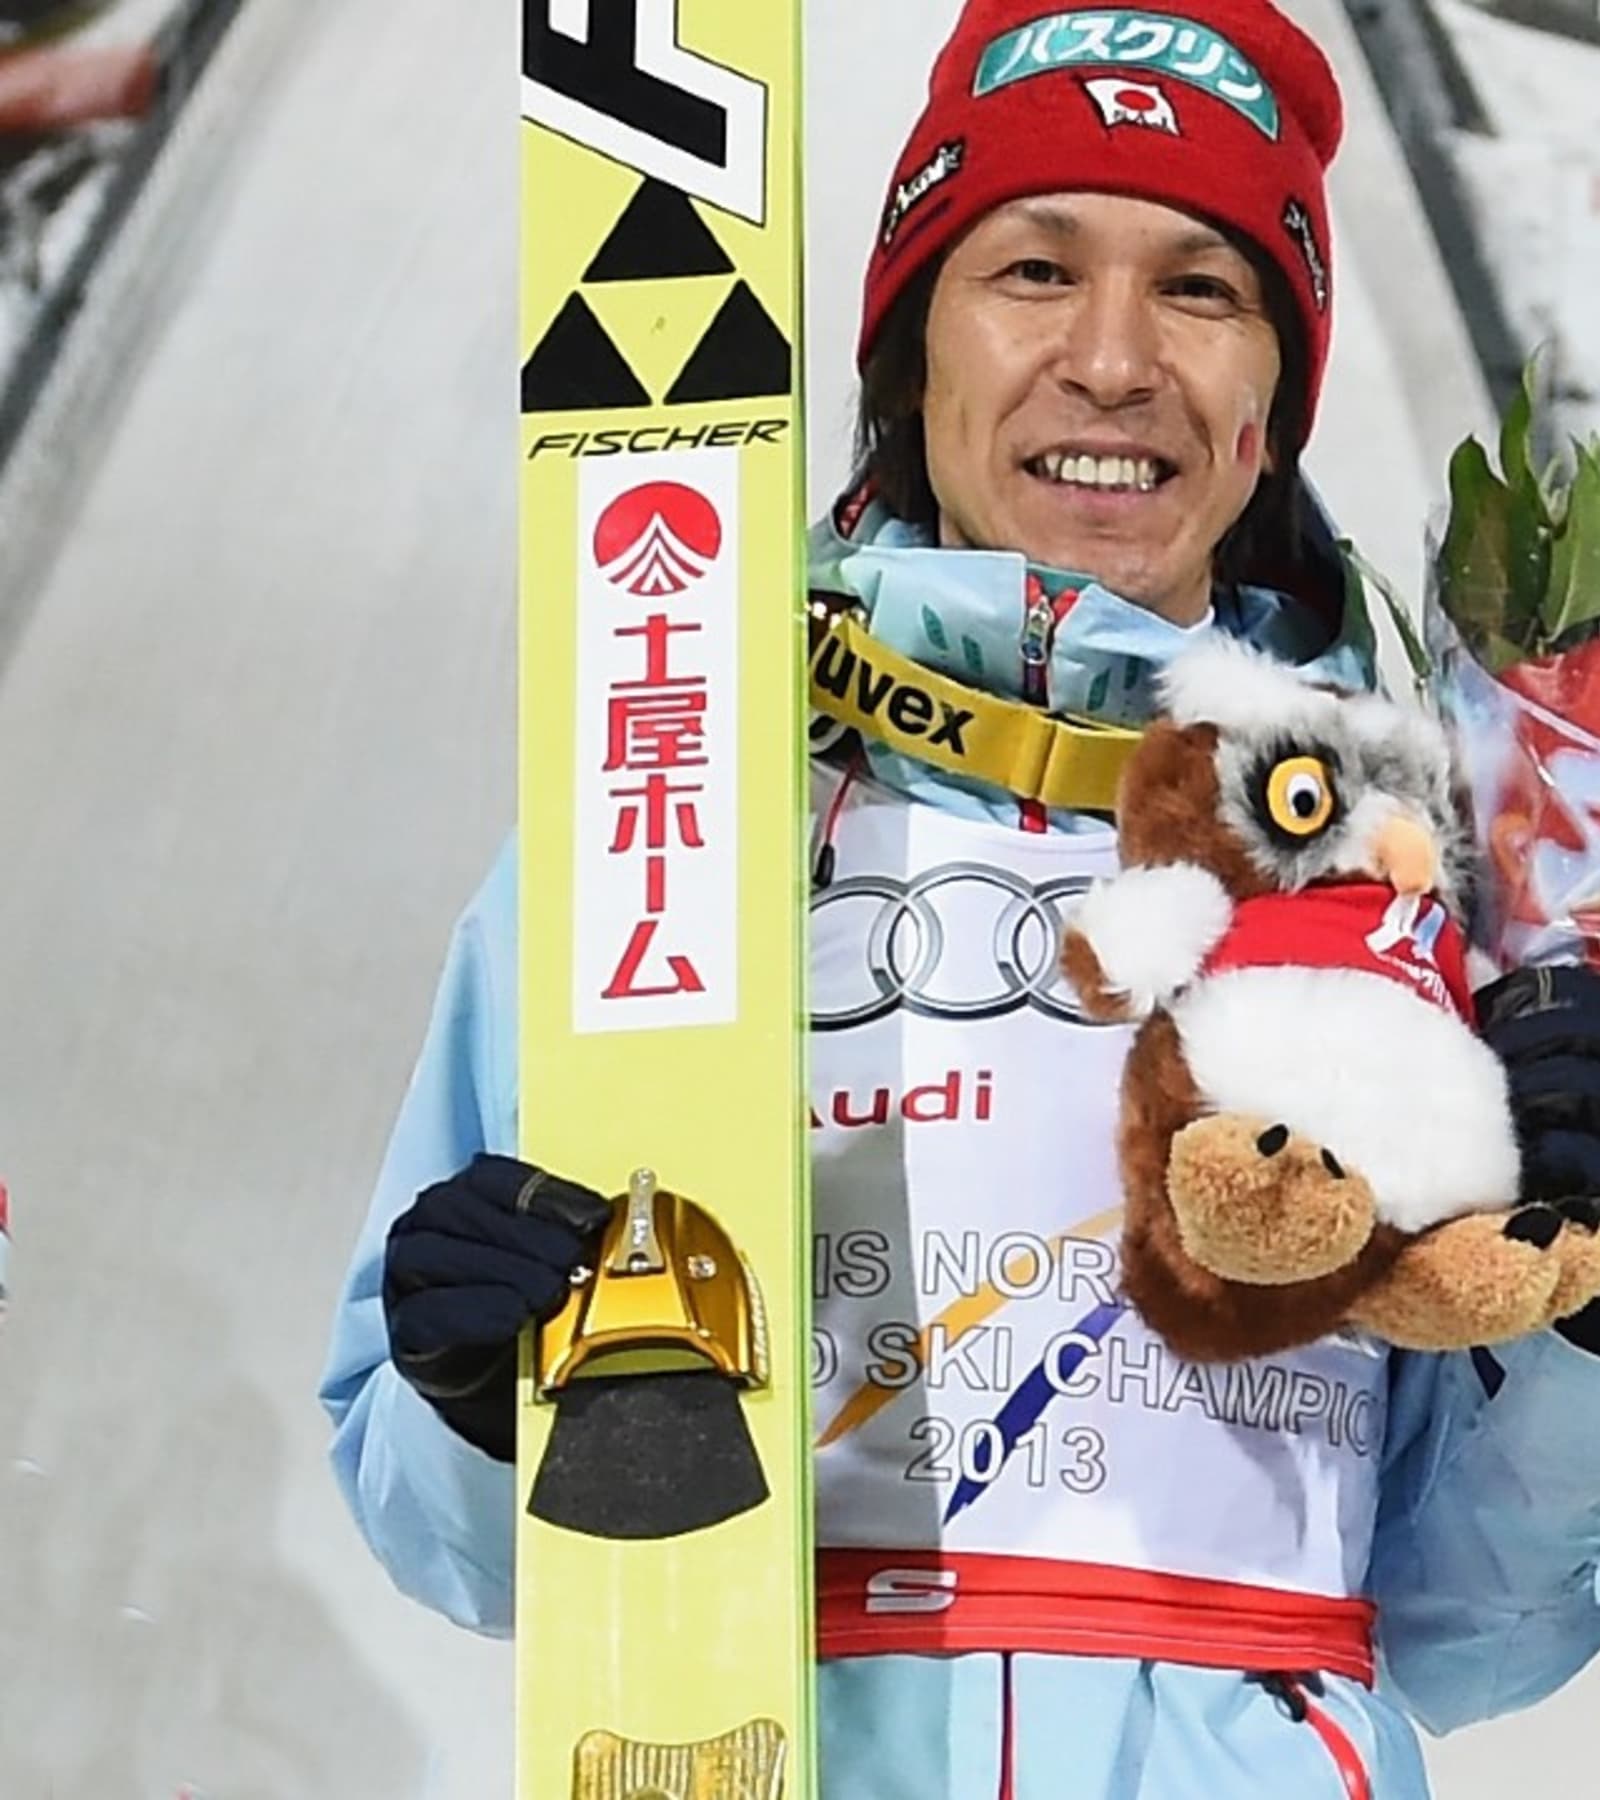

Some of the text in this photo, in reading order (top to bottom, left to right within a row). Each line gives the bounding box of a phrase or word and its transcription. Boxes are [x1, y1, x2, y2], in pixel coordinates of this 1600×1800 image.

[994, 14, 1263, 101] バスクリン
[528, 418, 791, 460] FISCHER
[814, 634, 975, 757] uvex
[601, 613, 709, 1000] 土屋ホーム
[809, 1069, 993, 1128] udi
[921, 1230, 1132, 1309] NOR
[865, 1320, 1013, 1393] SKI
[903, 1416, 1108, 1495] 2013
